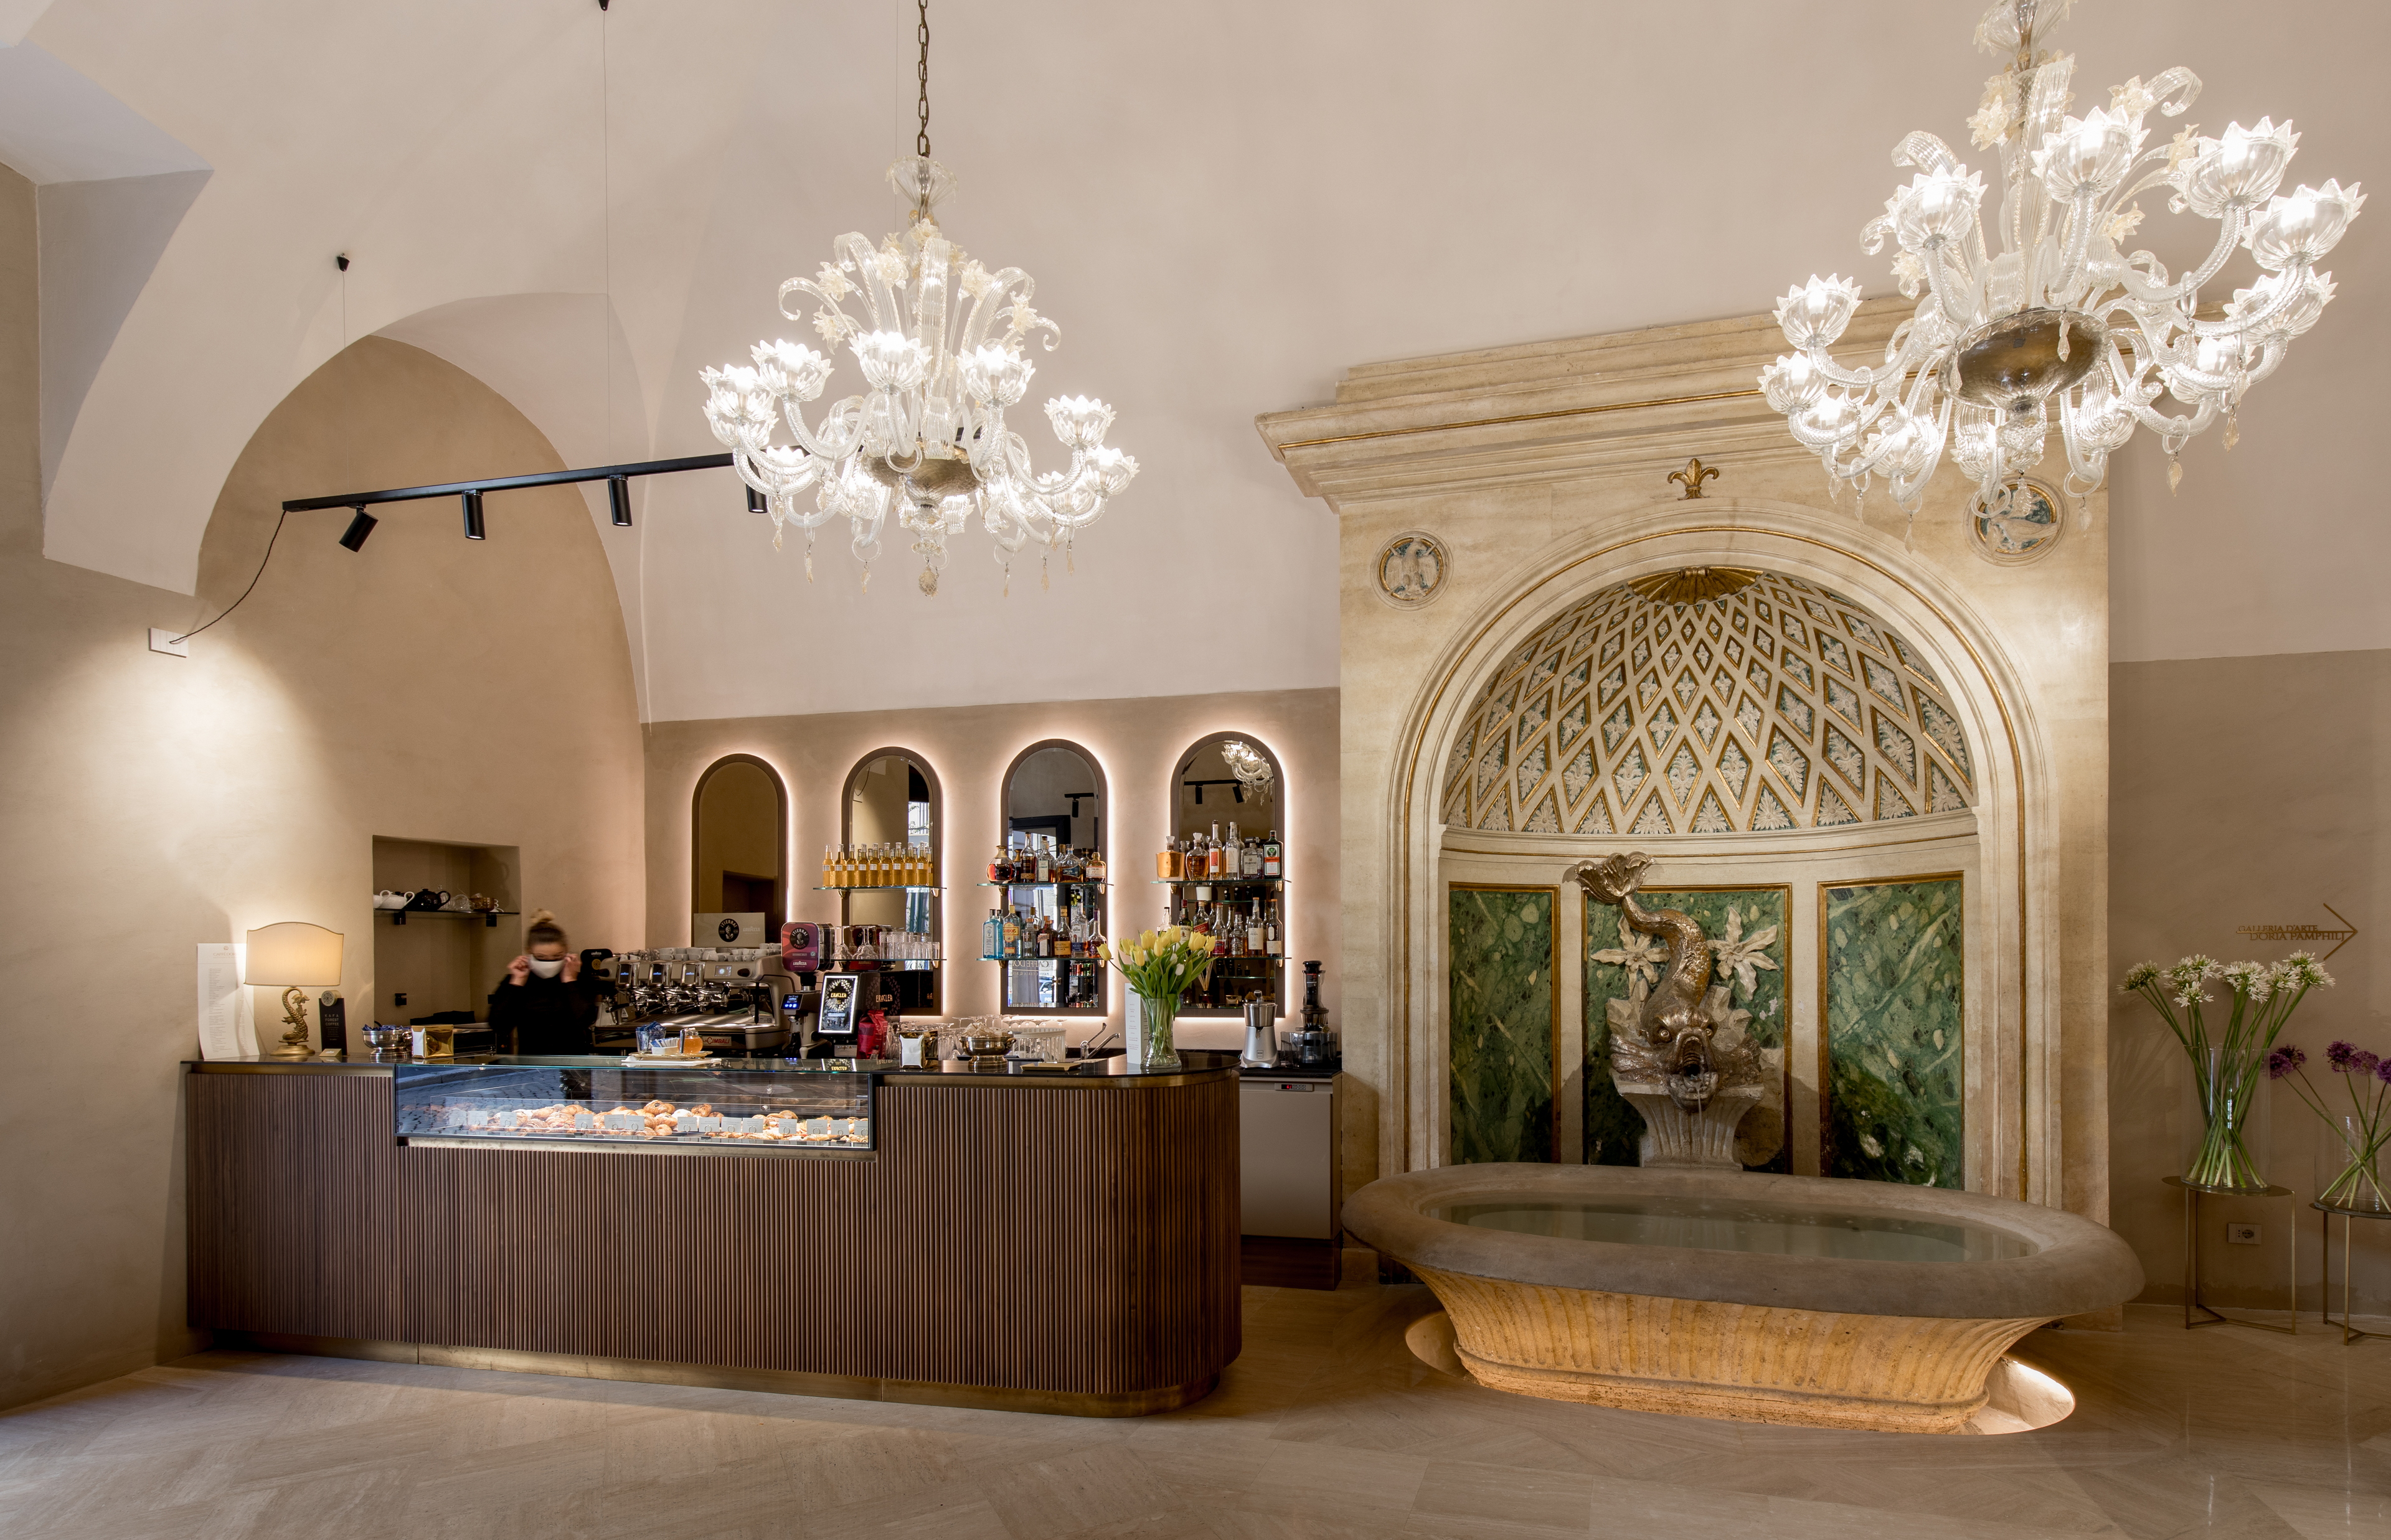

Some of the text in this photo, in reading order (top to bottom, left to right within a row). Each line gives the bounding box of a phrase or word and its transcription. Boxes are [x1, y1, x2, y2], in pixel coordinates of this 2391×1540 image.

[2250, 932, 2345, 942] DORIA PAMPHILJ
[876, 994, 893, 1002] ERACLEA
[707, 1036, 730, 1045] CIMBALI
